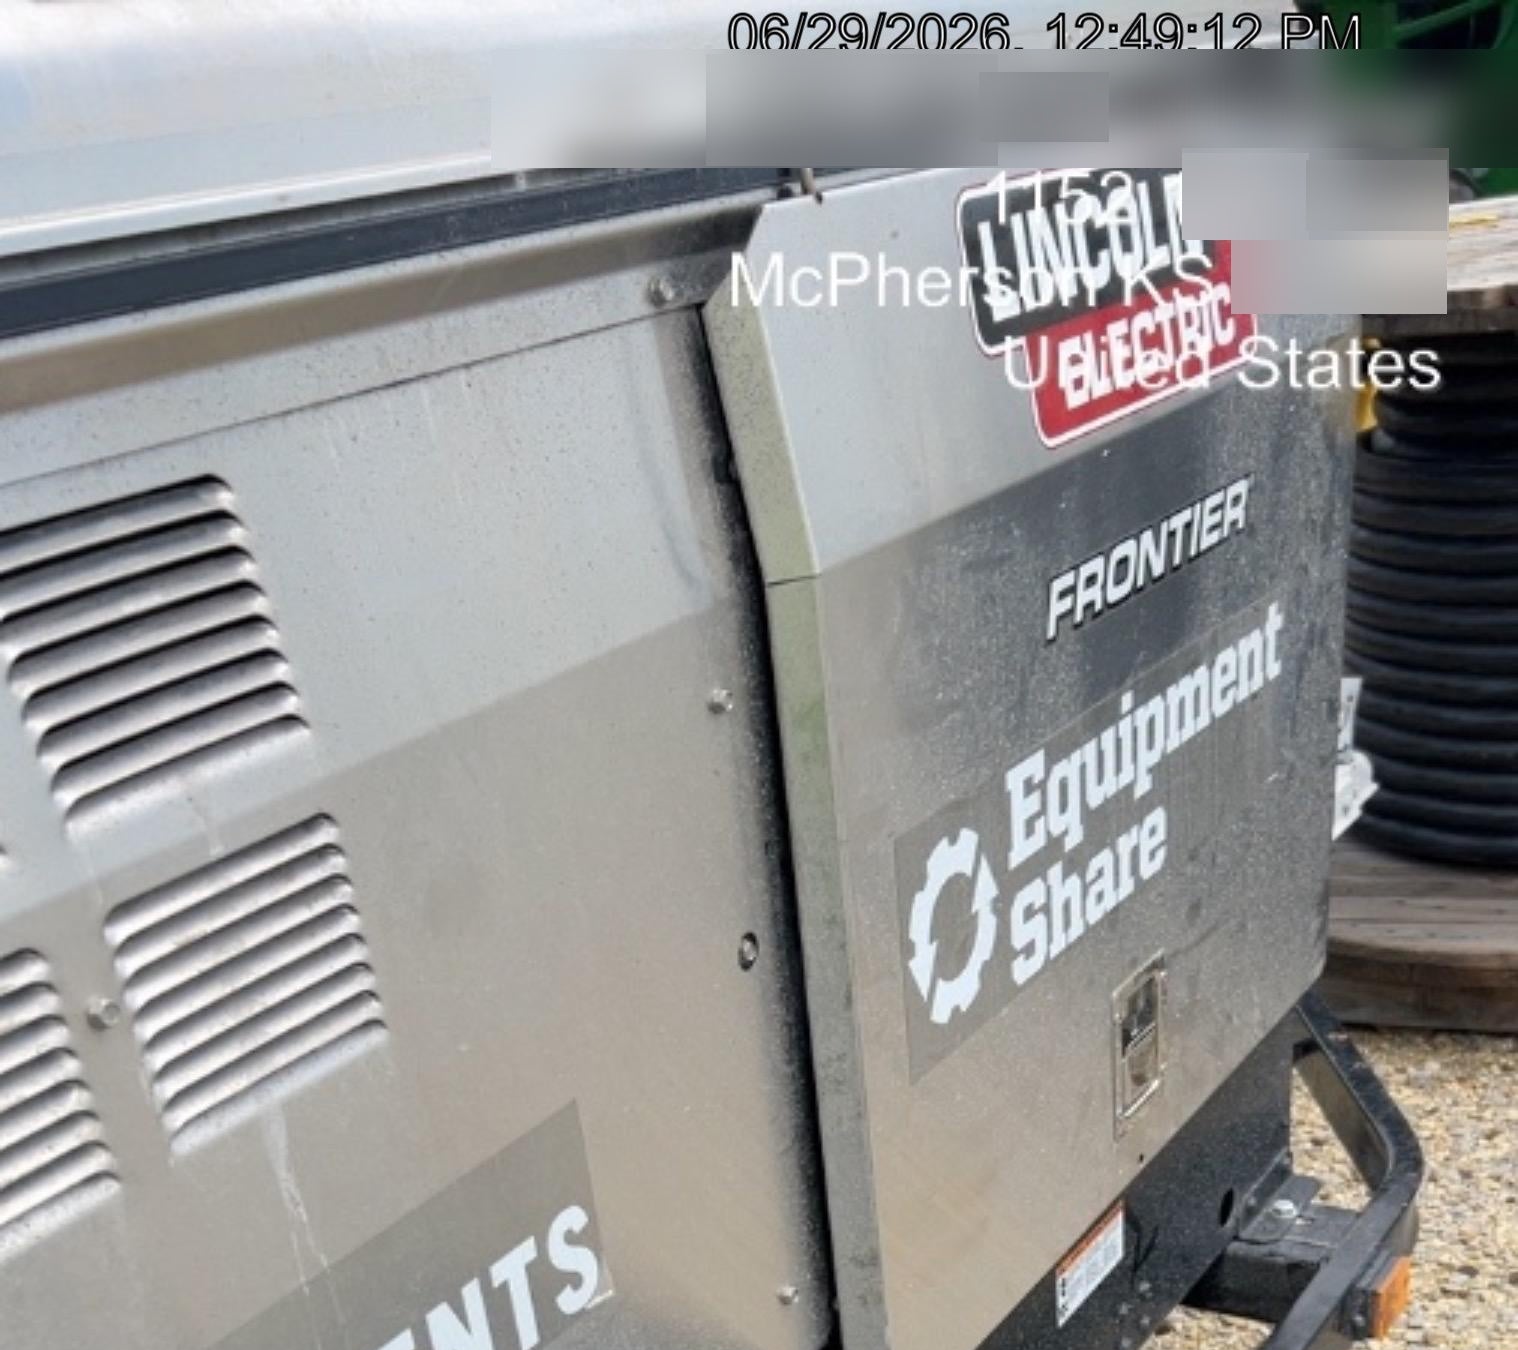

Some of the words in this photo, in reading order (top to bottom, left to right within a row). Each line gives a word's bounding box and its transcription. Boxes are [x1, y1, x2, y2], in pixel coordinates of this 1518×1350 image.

[1046, 473, 1254, 642] FRONTIER
[1005, 601, 1284, 871] Equipment
[1010, 805, 1168, 986] Share
